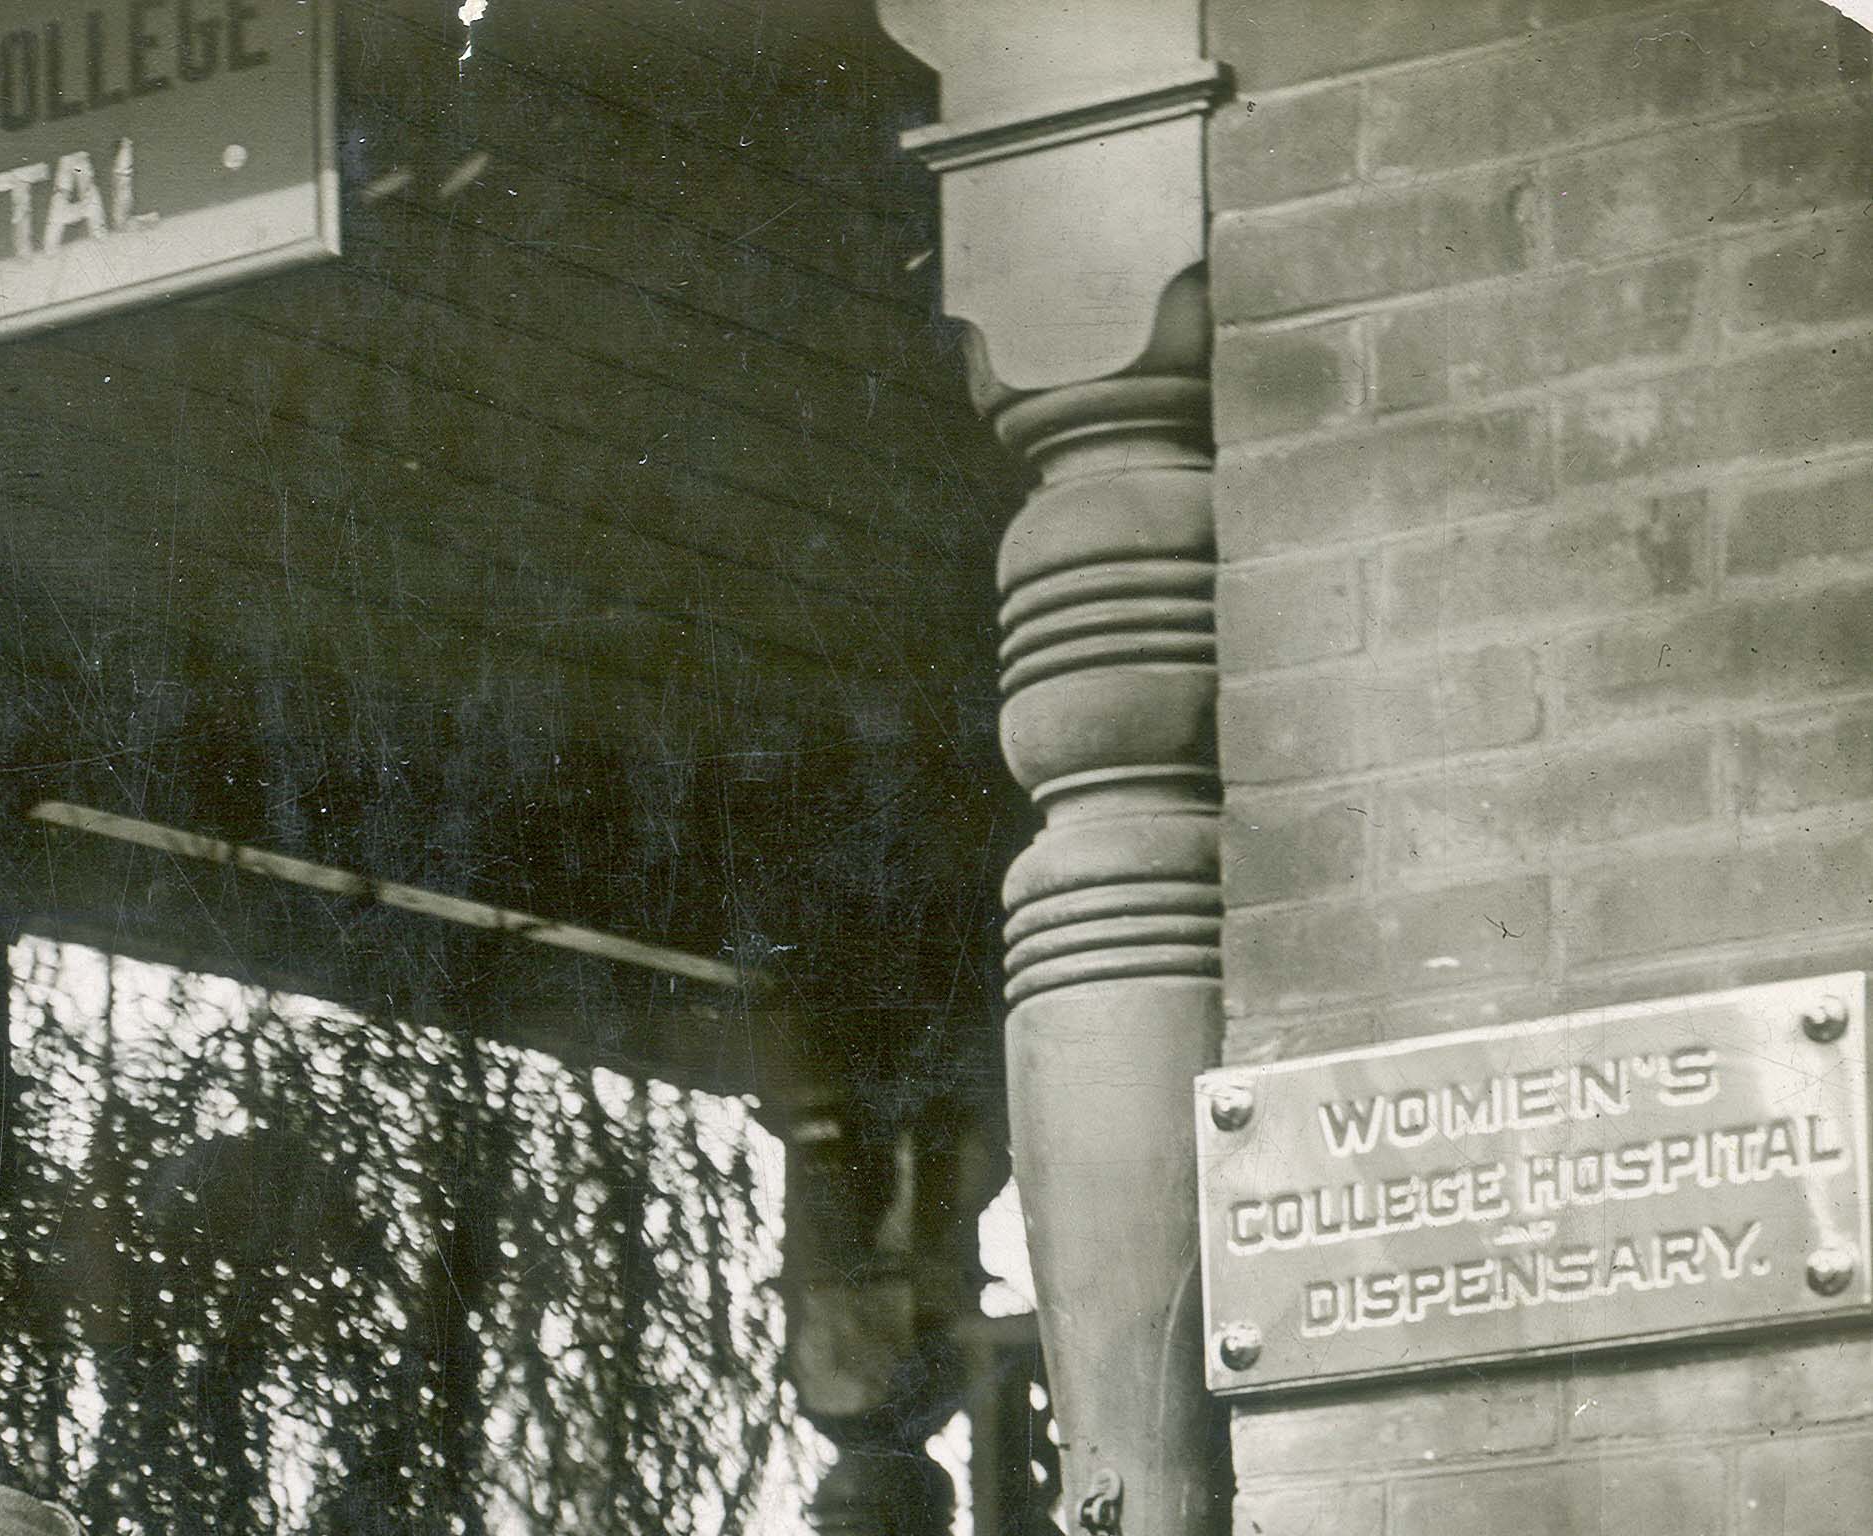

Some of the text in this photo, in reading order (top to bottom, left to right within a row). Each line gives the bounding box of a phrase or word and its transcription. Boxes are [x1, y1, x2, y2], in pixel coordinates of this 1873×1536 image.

[1318, 1044, 1720, 1158] WOMEN'S
[1227, 1113, 1851, 1255] COLLEGE HOSPITAL
[1301, 1221, 1771, 1338] DISPENSARY.
